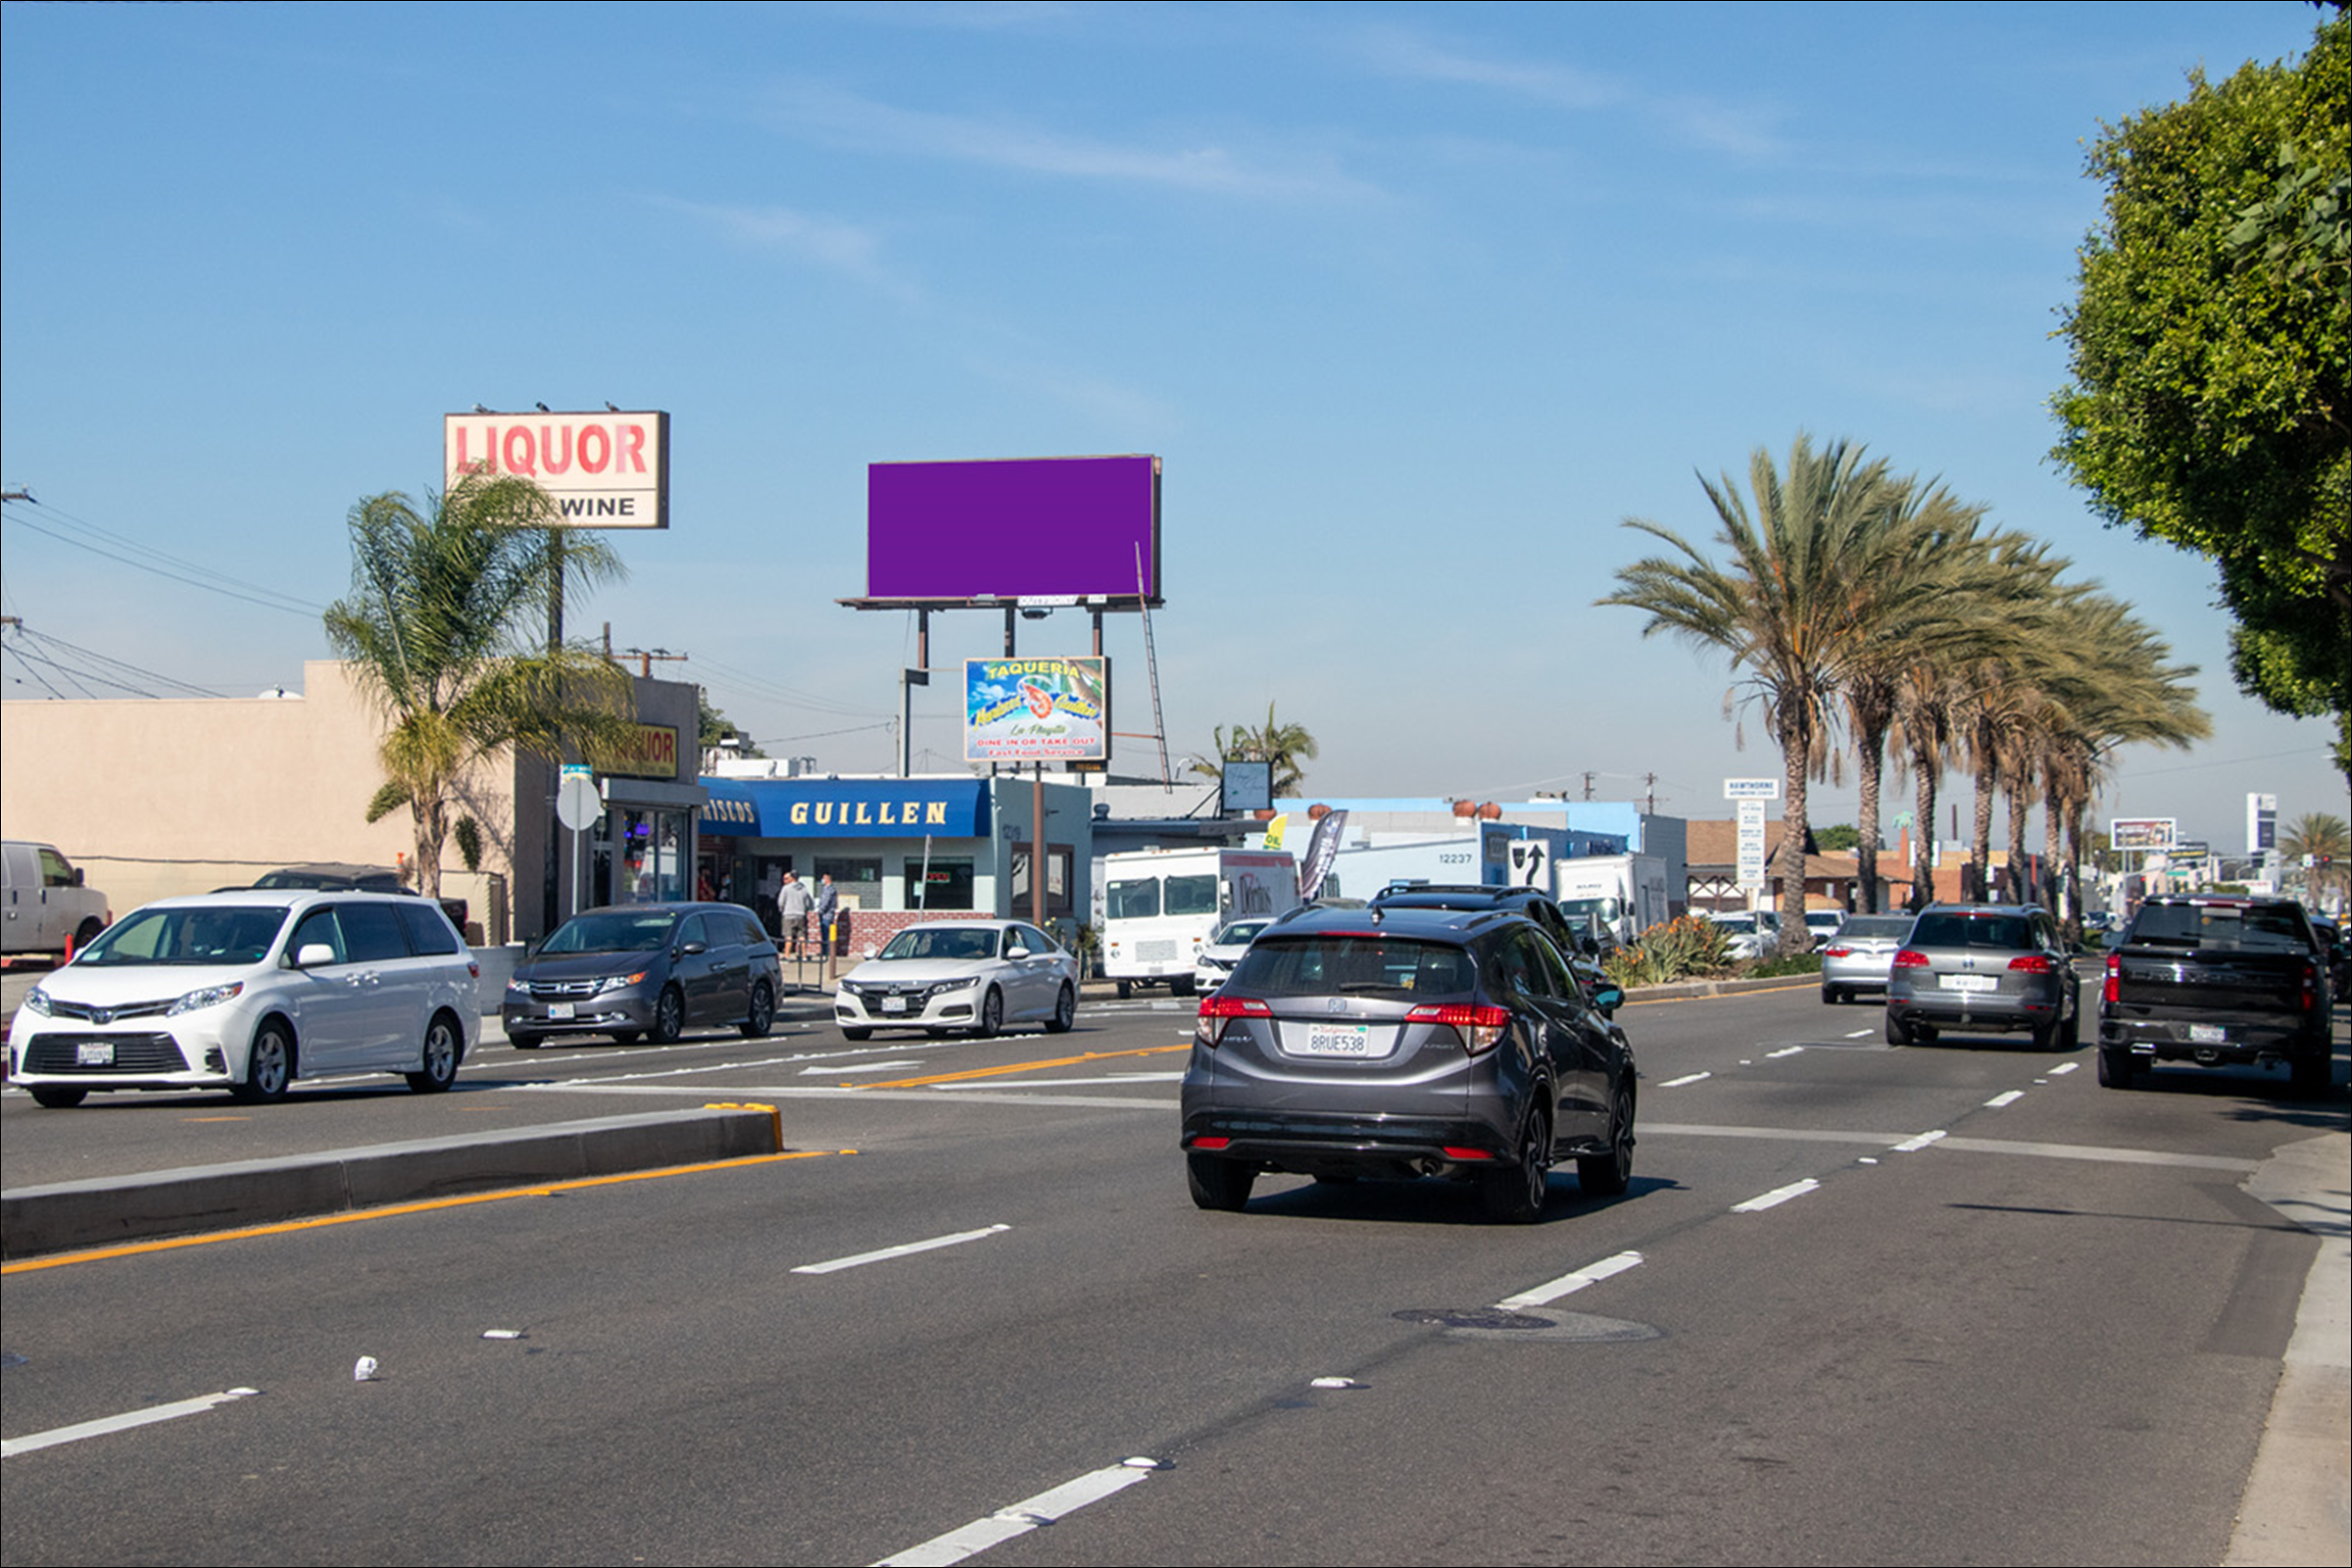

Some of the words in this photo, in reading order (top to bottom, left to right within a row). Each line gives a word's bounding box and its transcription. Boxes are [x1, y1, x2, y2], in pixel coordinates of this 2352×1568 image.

[456, 424, 647, 477] LIQUOR
[561, 498, 635, 515] WINE
[988, 662, 1080, 679] TAQUERIA
[790, 801, 948, 825] GUILLEN
[1265, 835, 1281, 846] OIL
[1439, 854, 1473, 863] 12237
[1310, 1035, 1365, 1052] 8RUE538
